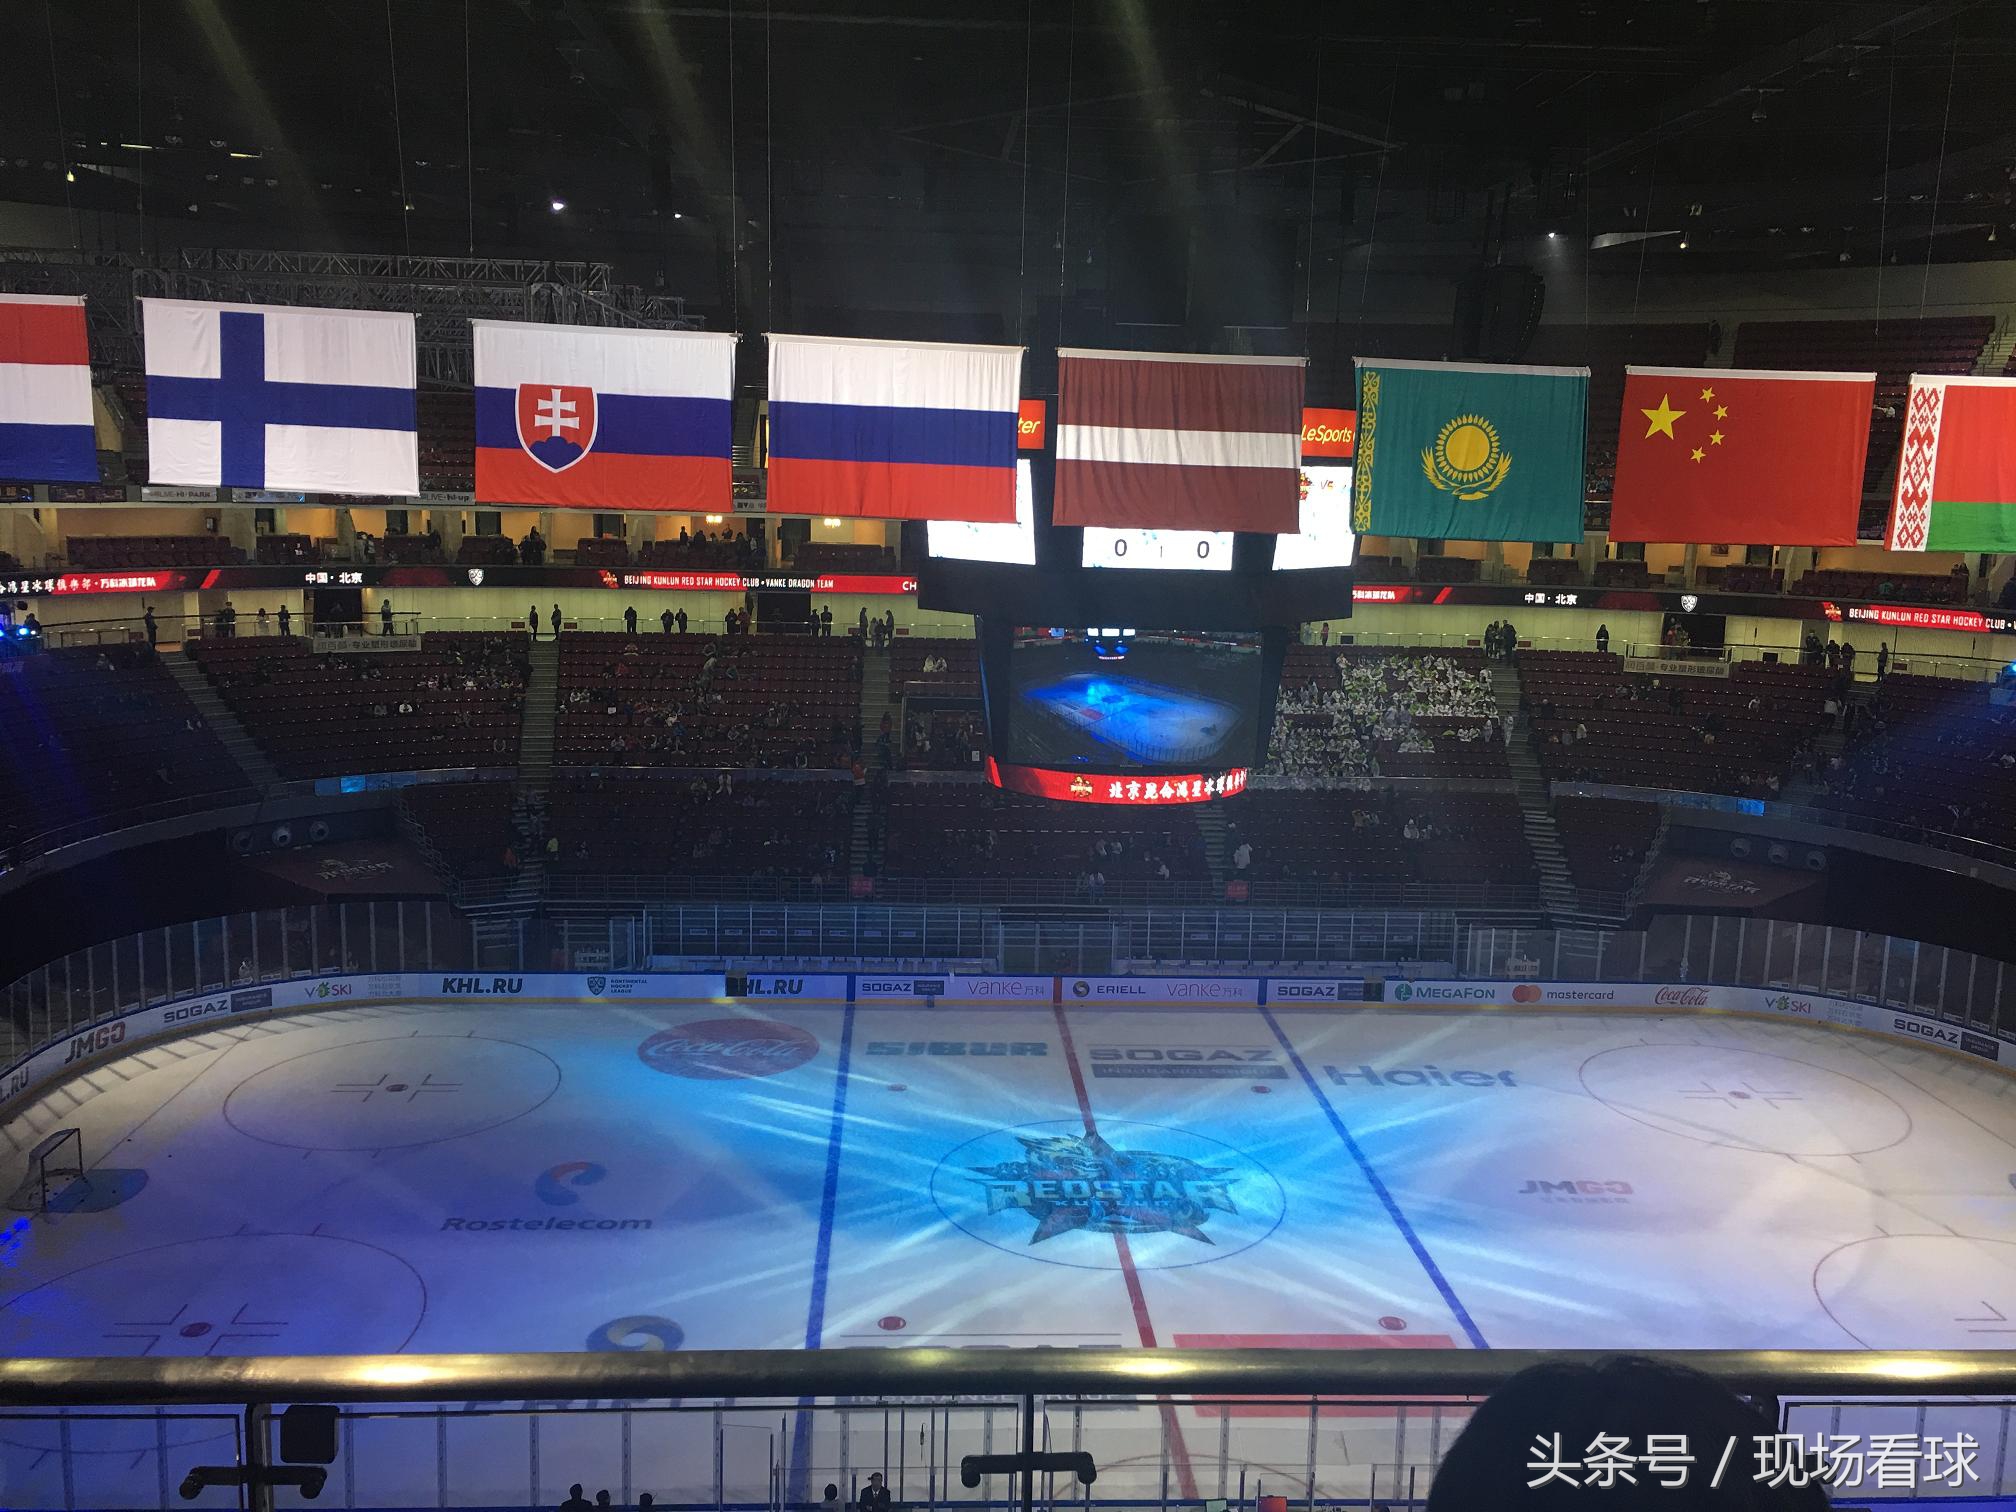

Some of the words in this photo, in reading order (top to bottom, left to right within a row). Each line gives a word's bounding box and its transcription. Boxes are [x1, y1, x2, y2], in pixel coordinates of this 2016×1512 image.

[1301, 424, 1352, 444] LeSports
[1115, 539, 1127, 556] 0
[1197, 541, 1210, 558] 0
[624, 576, 651, 584] BEIJING
[654, 576, 679, 585] KUNLUN
[681, 577, 694, 585] RED
[696, 577, 713, 586] STAR
[715, 578, 740, 586] HOCKEY
[742, 578, 760, 587] CLUB
[766, 578, 786, 588] VANKE
[788, 579, 815, 588] DRAGON
[817, 580, 834, 588] TEAM
[1849, 608, 1879, 619] BEIJING
[1881, 611, 1911, 622] KUNLUN
[1914, 612, 1929, 623] RED
[1931, 615, 1950, 625] STAR
[1953, 617, 1983, 628] HOCKEY
[1985, 619, 2005, 629] CLUB
[442, 978, 523, 994] KHL.RU
[862, 983, 912, 992] SOGAZ
[967, 980, 1022, 996] vanke
[1097, 985, 1147, 995] ERIELL
[1166, 982, 1221, 998] vanke
[1277, 986, 1336, 997] SOGAZ
[1547, 990, 1615, 1001] mastercard
[1655, 986, 1712, 1006] Coca-Cola
[163, 1000, 228, 1023] SOGAZ
[1894, 1018, 1959, 1045] SOGAZ
[865, 1042, 1048, 1056] SIBUR
[1090, 1049, 1278, 1062] SOGAZ
[1323, 1065, 1518, 1087] Haier
[440, 1217, 654, 1231] Rostelecom
